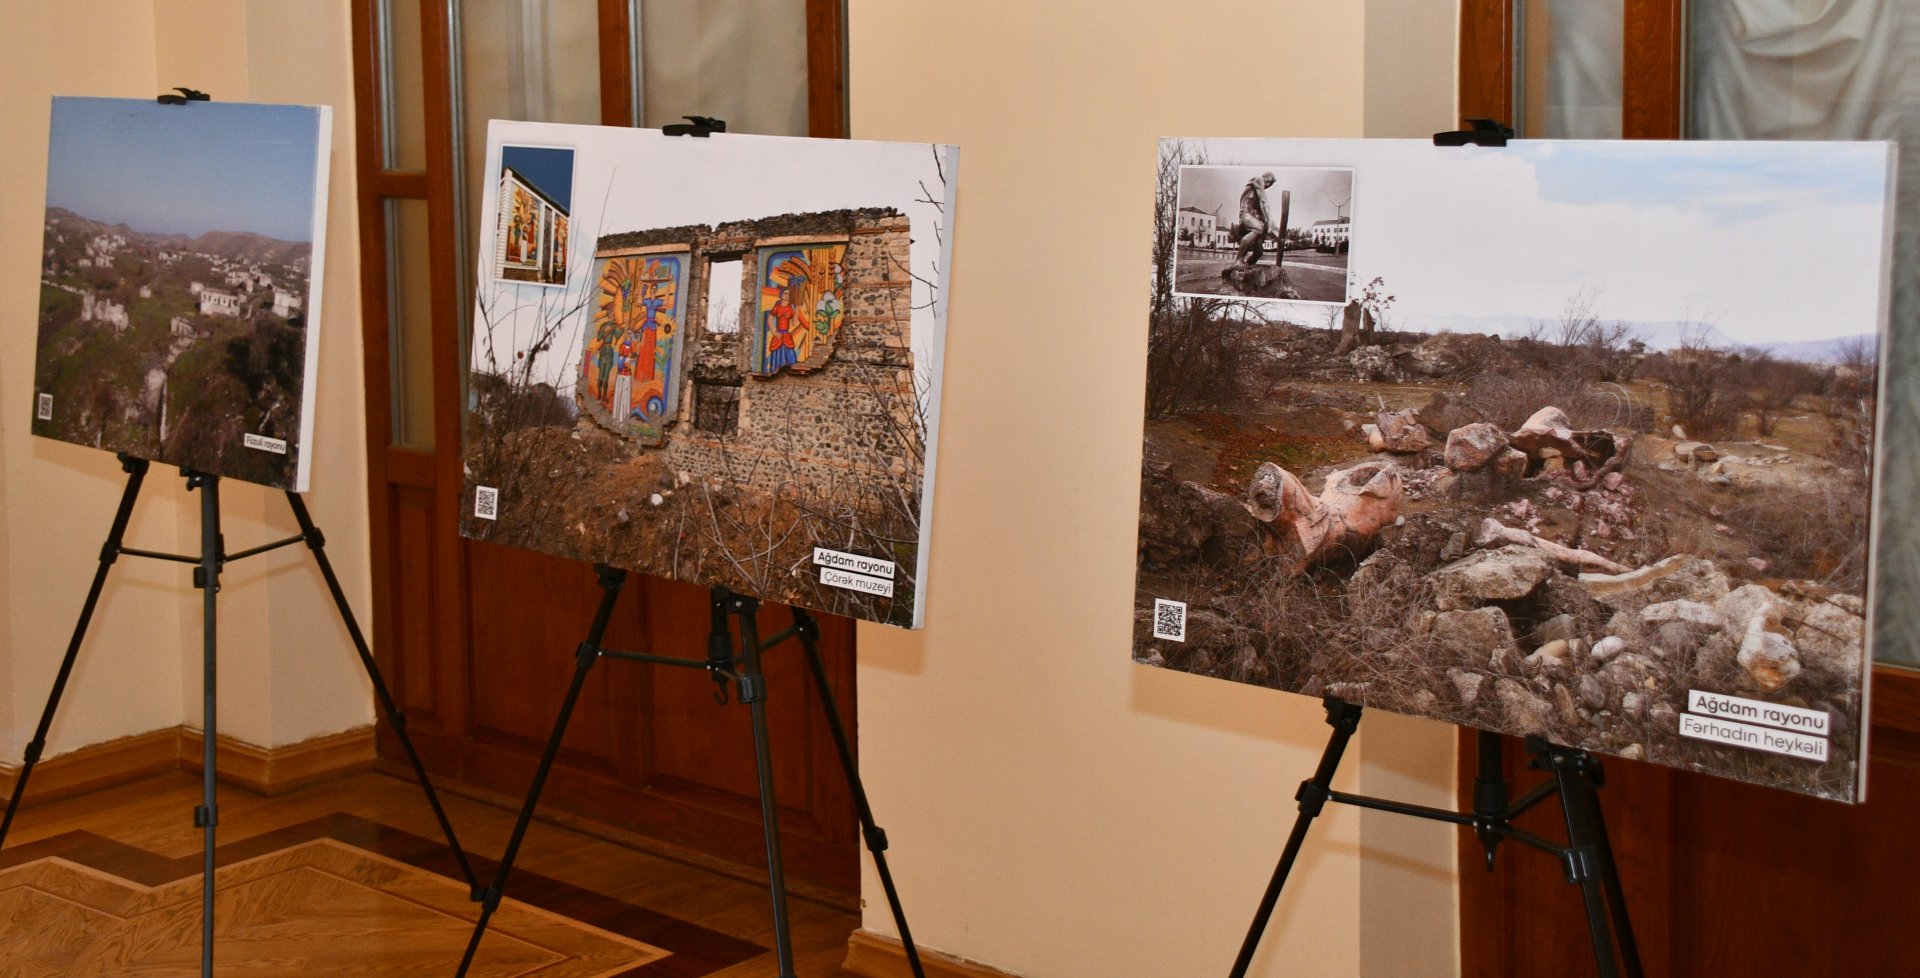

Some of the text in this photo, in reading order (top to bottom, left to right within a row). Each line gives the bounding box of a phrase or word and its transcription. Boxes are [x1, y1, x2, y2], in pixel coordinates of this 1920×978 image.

[818, 552, 892, 574] Ağdam rayonu
[824, 571, 891, 594] Çörək muzeyi
[1696, 696, 1824, 729] Ağdam rayonu
[1684, 718, 1823, 755] Fərhadın heykəli
